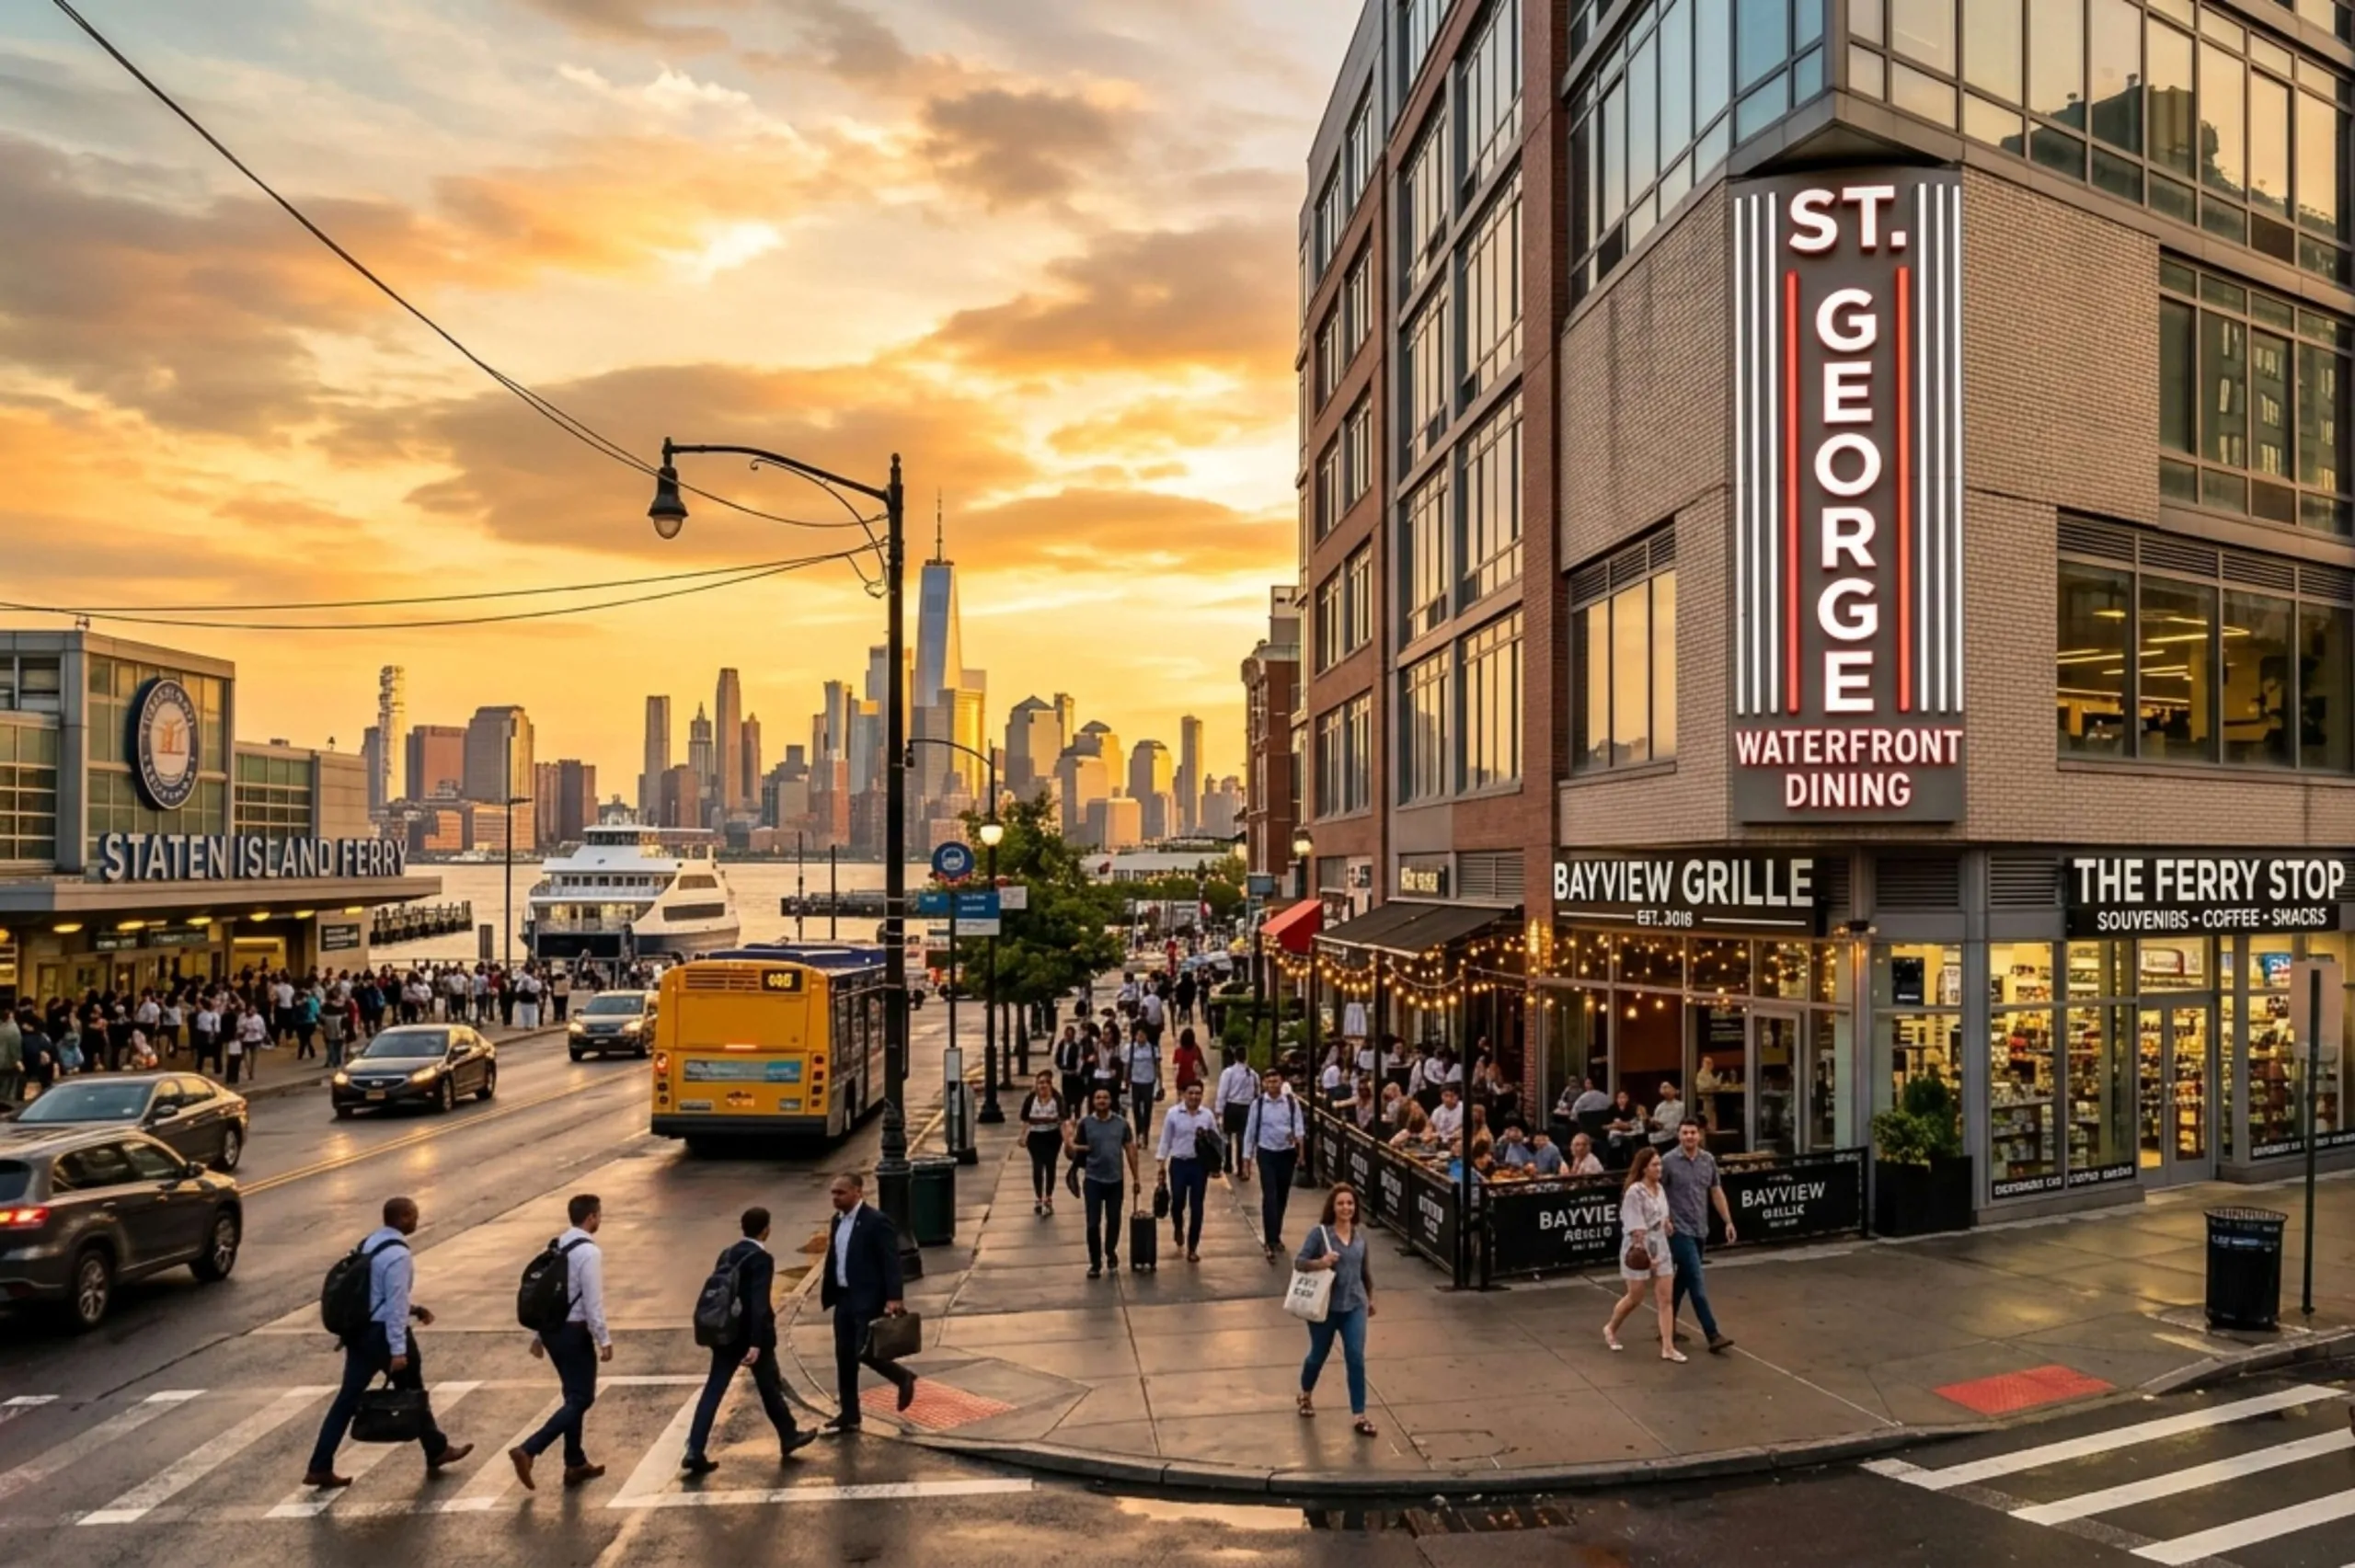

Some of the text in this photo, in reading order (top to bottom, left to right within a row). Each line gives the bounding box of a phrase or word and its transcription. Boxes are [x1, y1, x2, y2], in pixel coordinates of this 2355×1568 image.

[1788, 185, 1907, 252] ST.
[1813, 287, 1882, 714] GEORGE
[1735, 727, 1964, 765] WATERFRONT
[1785, 771, 1912, 807] DINING
[103, 832, 408, 880] STATEN ISLAND FERRY
[1553, 858, 1814, 908] BAYVIEW GRILLE
[2073, 857, 2347, 903] THE FERRY STOP
[1539, 1203, 1617, 1230] BAYVIE
[1740, 1181, 1826, 1208] BAYVIEW
